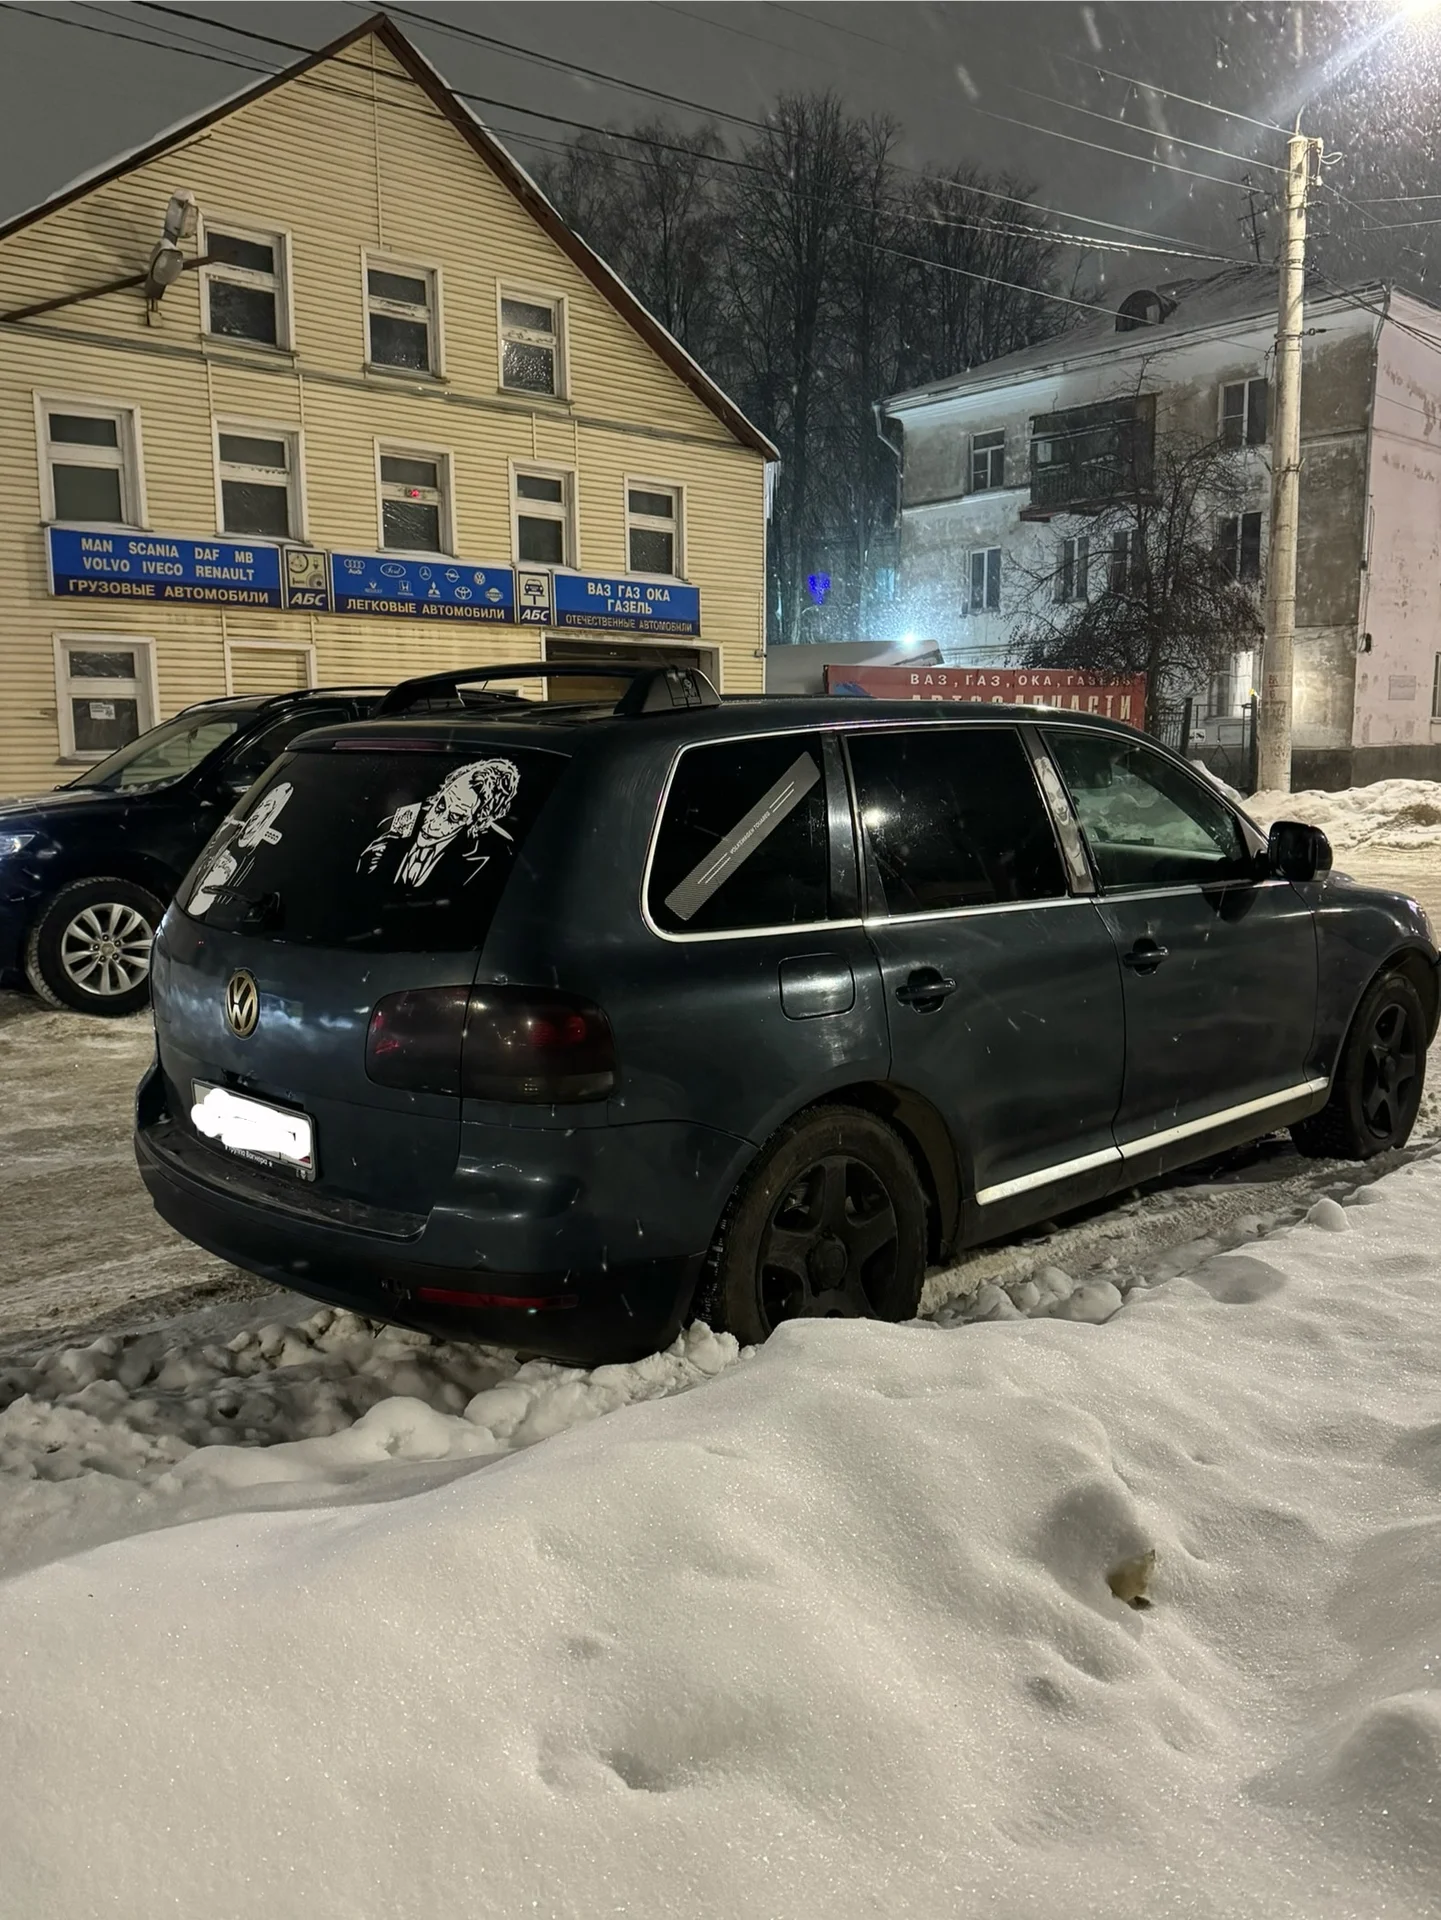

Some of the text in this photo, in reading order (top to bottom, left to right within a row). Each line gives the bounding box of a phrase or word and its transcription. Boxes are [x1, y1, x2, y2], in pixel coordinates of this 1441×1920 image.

[81, 537, 253, 564] MAN SCANIA DAF MB
[83, 556, 255, 581] VOLVO IVECO RENAULT
[69, 579, 269, 604] ГРУЗОВЫЕ АВТОМОБИЛИ
[290, 592, 326, 607] АБС
[587, 582, 670, 602] ВАЗ ГАЗ ОКА
[346, 598, 505, 619] ЛЕГКОВЫЕ АВТОМОБИЛИ
[521, 609, 550, 622] АБС
[607, 599, 653, 615] ГАЗЕЛЬ
[565, 613, 693, 633] ОТЕЧЕСТВЕННЫЕ АВТОМОБИЛИ
